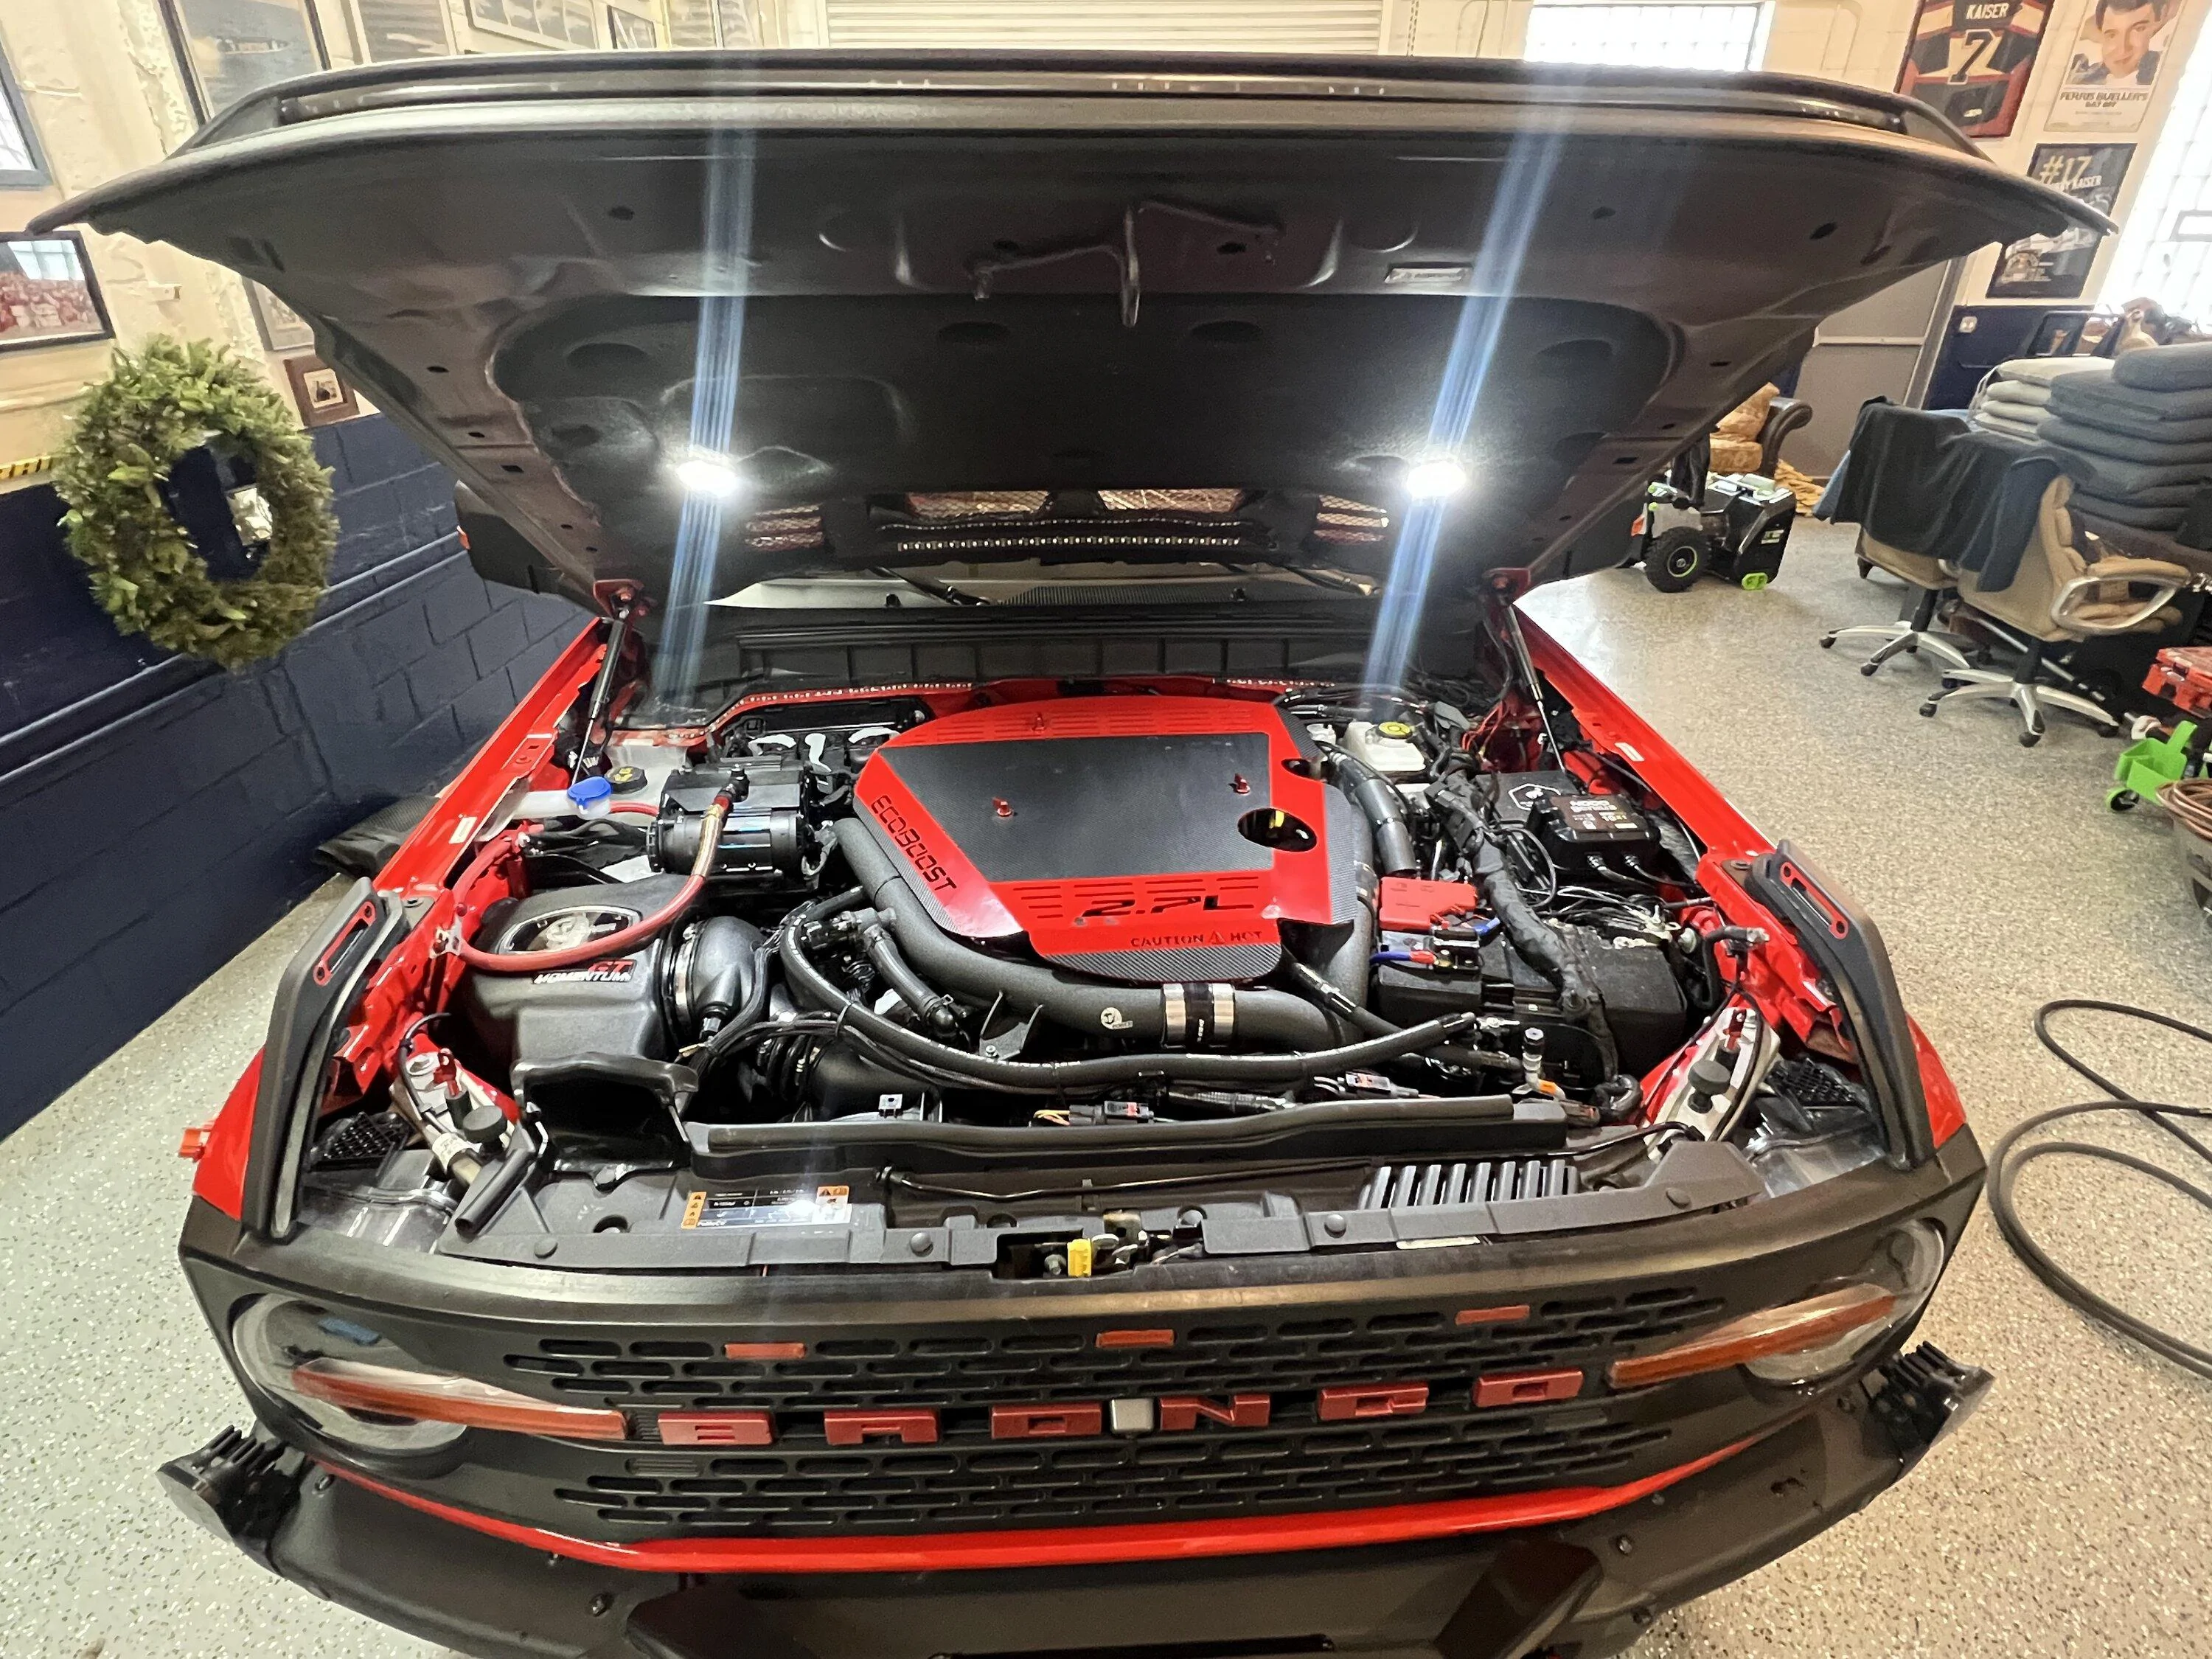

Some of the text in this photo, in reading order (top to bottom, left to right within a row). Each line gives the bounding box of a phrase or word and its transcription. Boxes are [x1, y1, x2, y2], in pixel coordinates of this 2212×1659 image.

[1966, 3, 2009, 20] KAISER
[1947, 28, 1995, 85] 7
[871, 795, 957, 891] ECOBOOST
[1082, 895, 1254, 917] 2.7L
[1130, 931, 1262, 947] CAUTION HOT
[533, 971, 632, 984] MOMENTUM
[656, 1368, 1585, 1446] BRONCO
